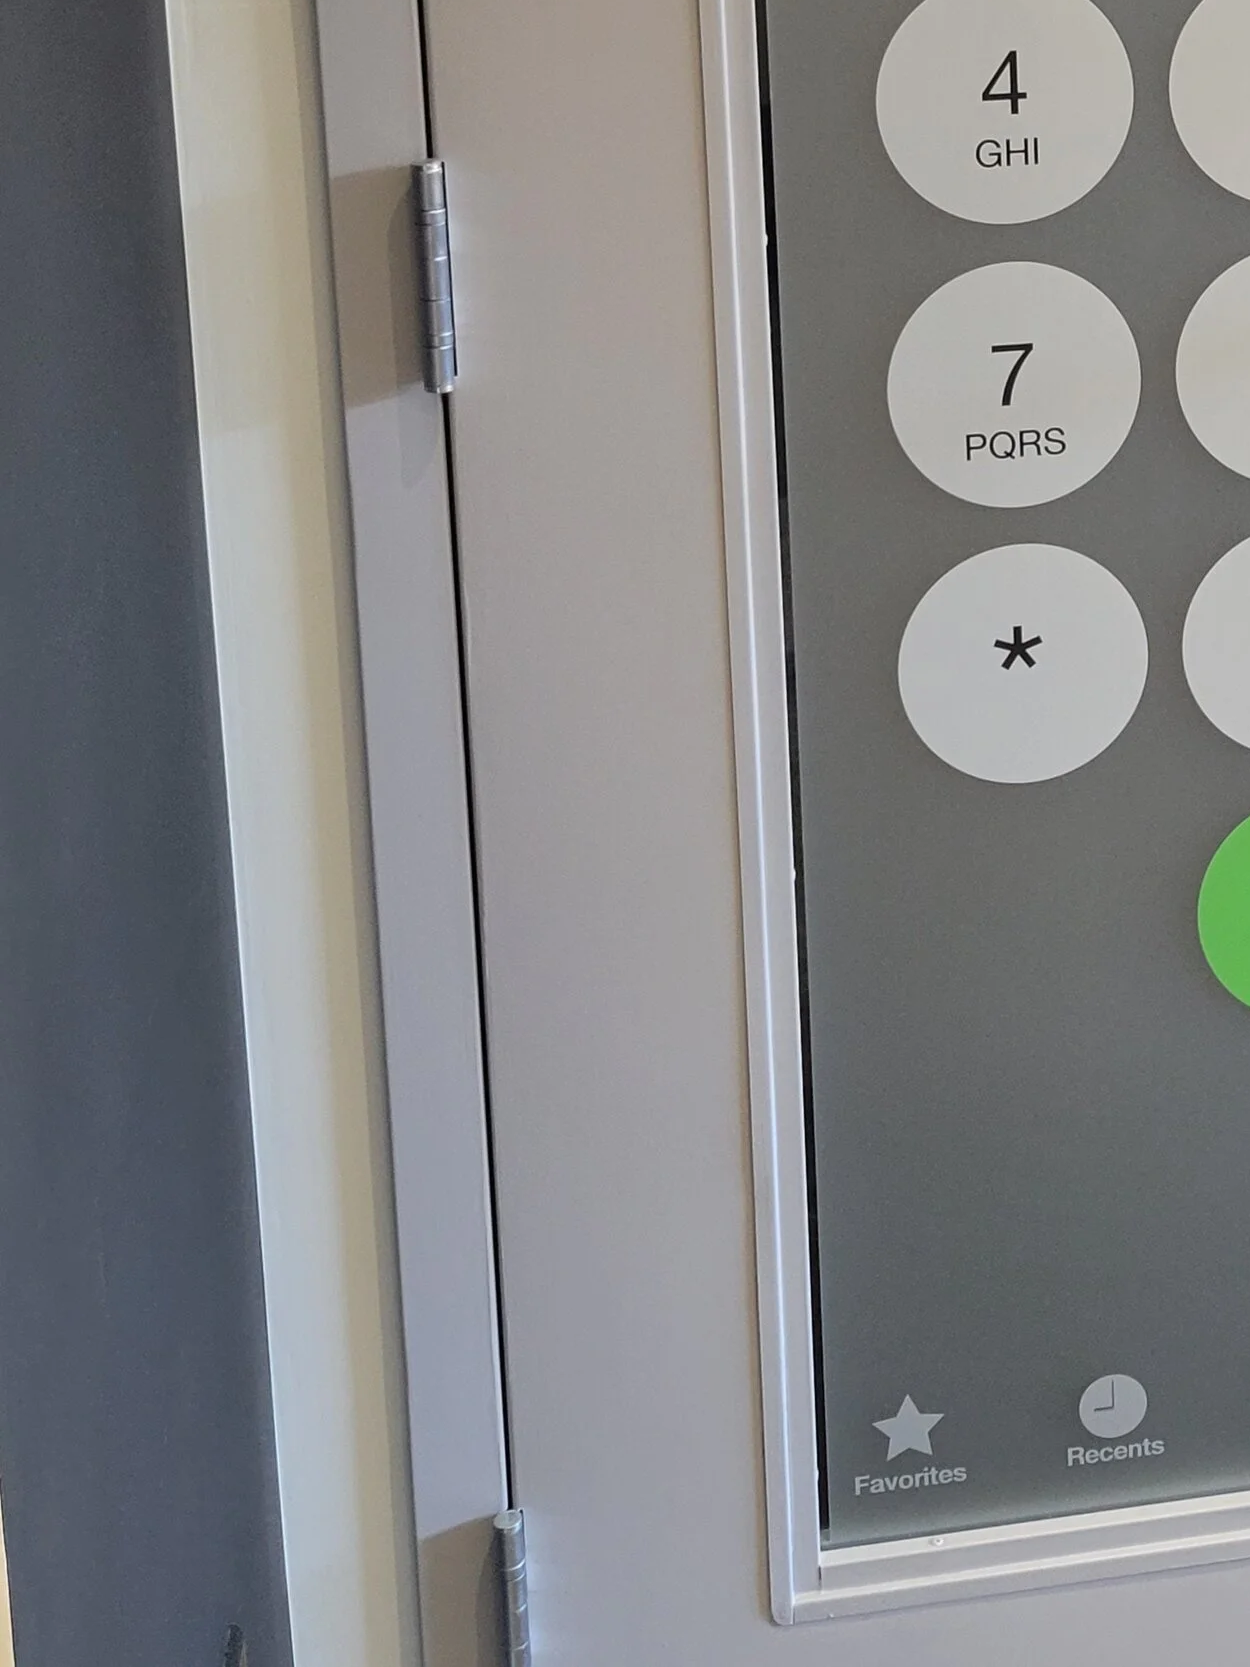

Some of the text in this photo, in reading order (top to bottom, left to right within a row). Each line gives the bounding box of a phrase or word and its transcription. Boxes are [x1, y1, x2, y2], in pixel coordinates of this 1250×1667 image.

[981, 50, 1028, 115] 4
[975, 137, 1039, 168] GHI
[991, 342, 1034, 407] 7
[965, 427, 1067, 461] PQRS
[1067, 1437, 1165, 1467] Recents
[854, 1463, 967, 1496] Favorites
